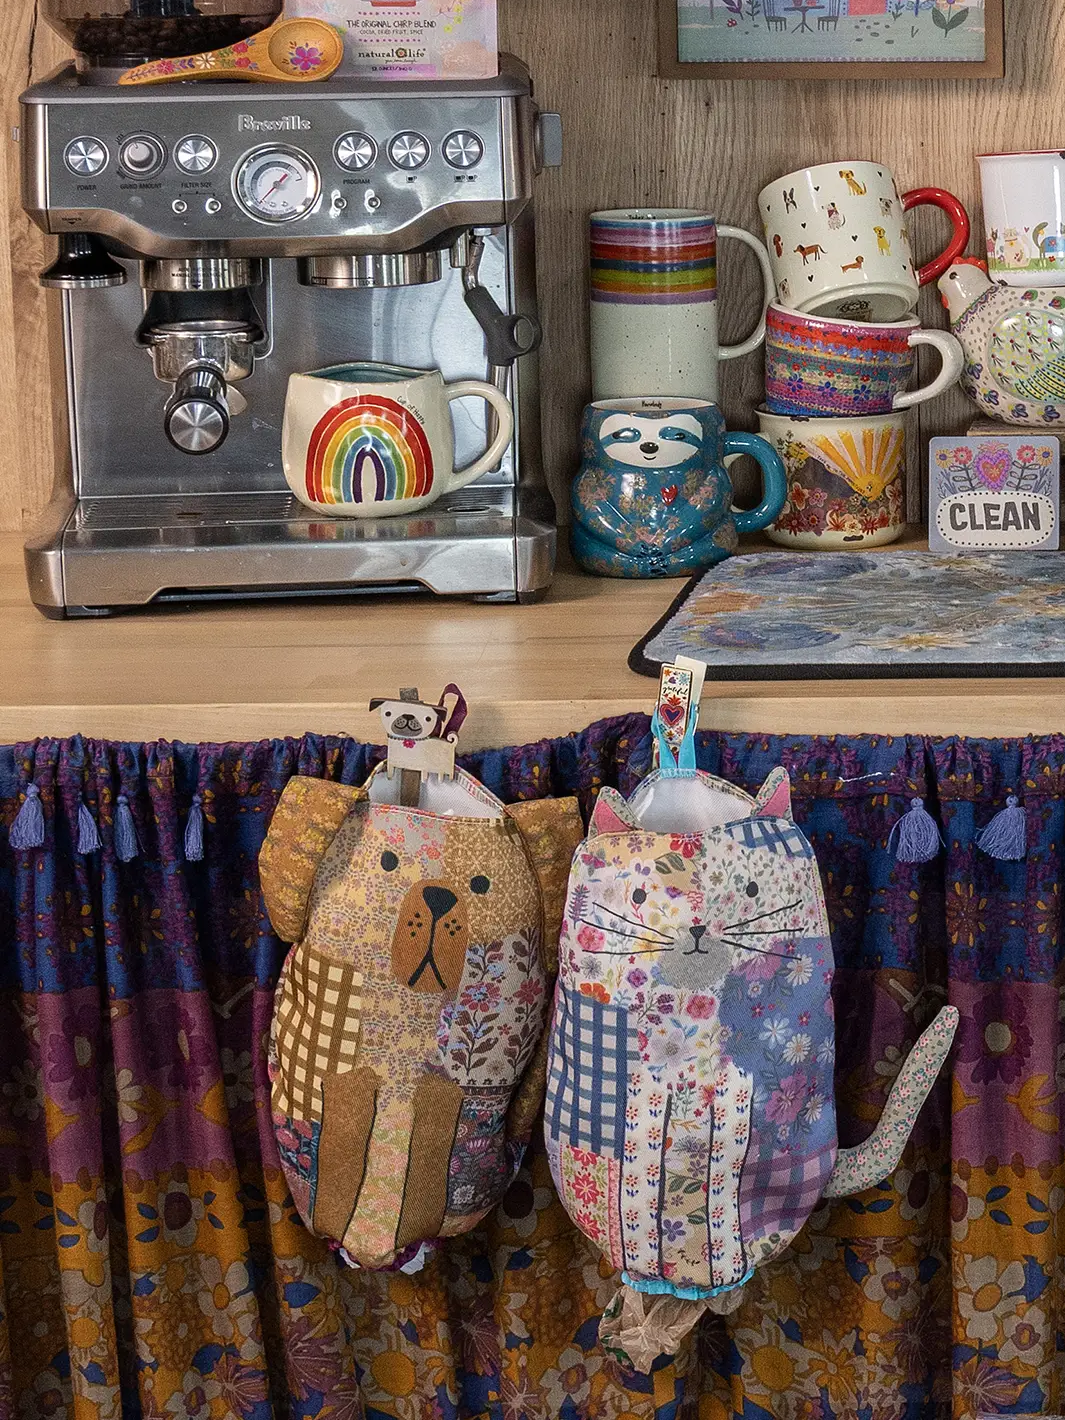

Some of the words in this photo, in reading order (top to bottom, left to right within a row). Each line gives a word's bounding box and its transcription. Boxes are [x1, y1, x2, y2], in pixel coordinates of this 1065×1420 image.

[346, 19, 360, 28] THE
[413, 19, 437, 28] BLEND
[357, 48, 395, 58] natural
[237, 114, 312, 132] Breville
[949, 501, 1042, 531] CLEAN
